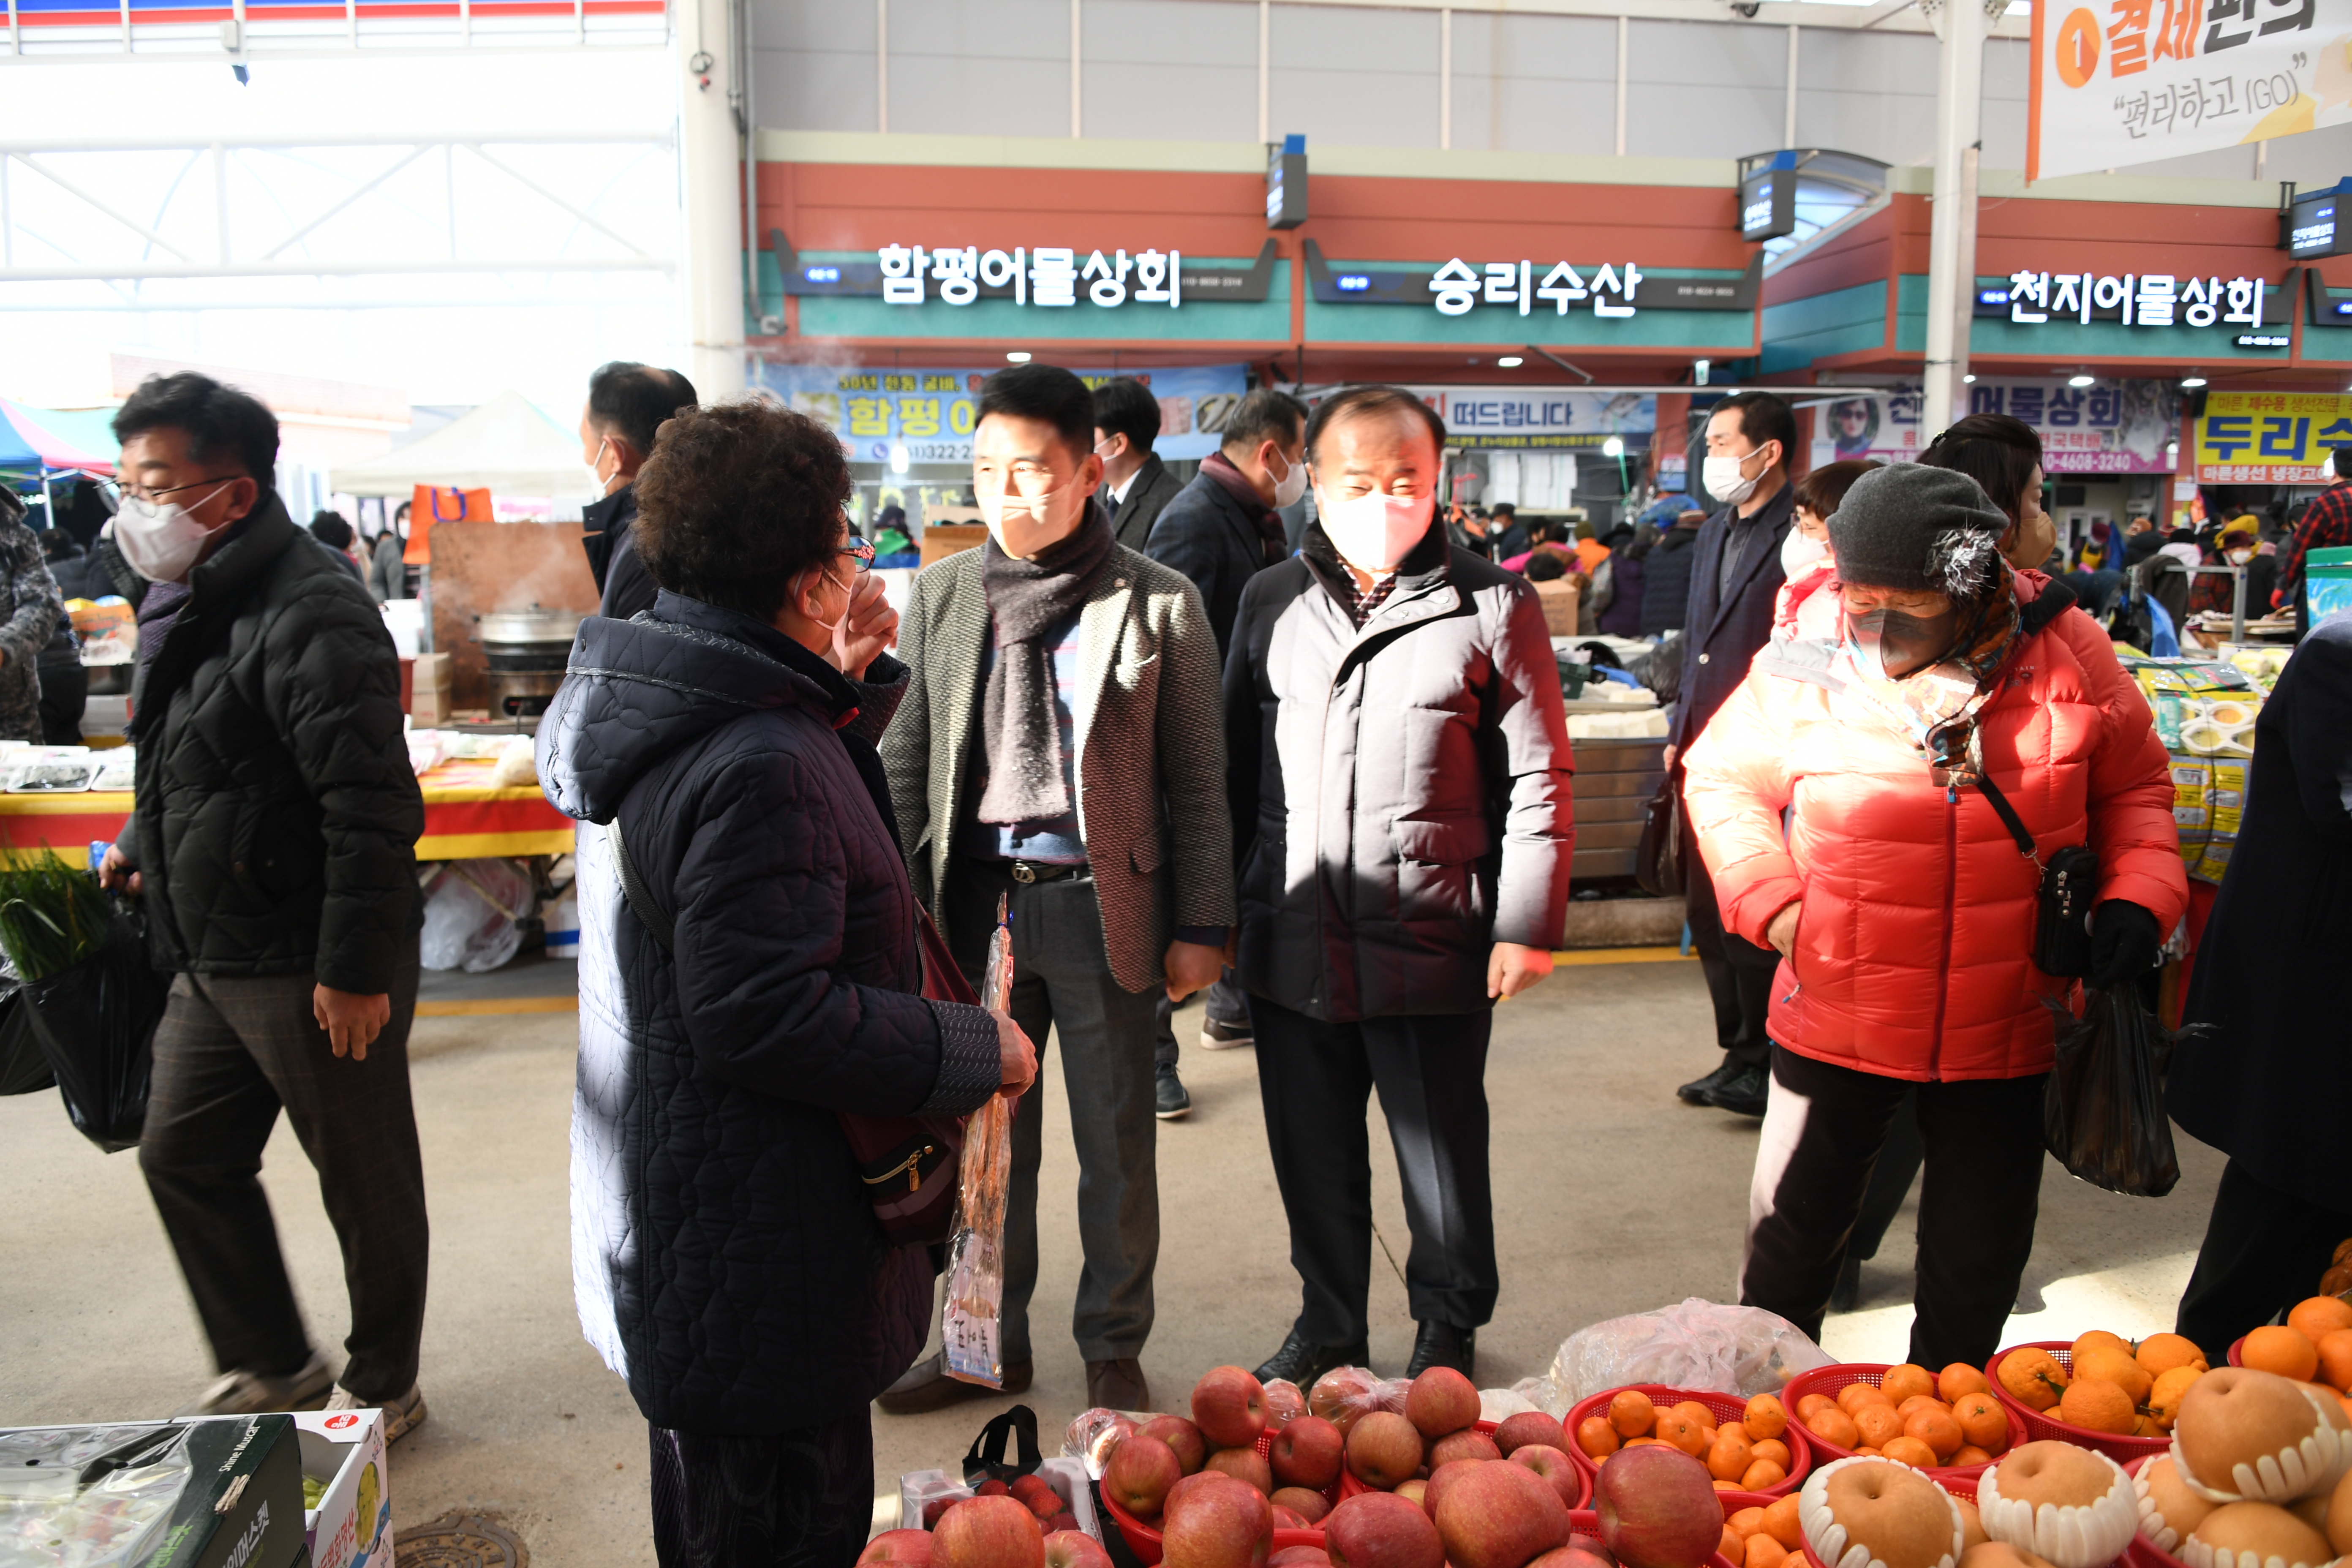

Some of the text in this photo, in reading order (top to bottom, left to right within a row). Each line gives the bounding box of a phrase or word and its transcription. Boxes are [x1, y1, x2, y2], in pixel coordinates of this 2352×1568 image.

[878, 243, 1180, 308] 함평어물상회
[1429, 257, 1643, 317] 승리수산
[2009, 270, 2264, 328] 천지어물상회
[1454, 401, 1572, 427] 떠드립니다
[2218, 397, 2243, 412] 마른
[2203, 466, 2266, 482] 마른생선
[218, 1426, 261, 1472] Shine Muscat
